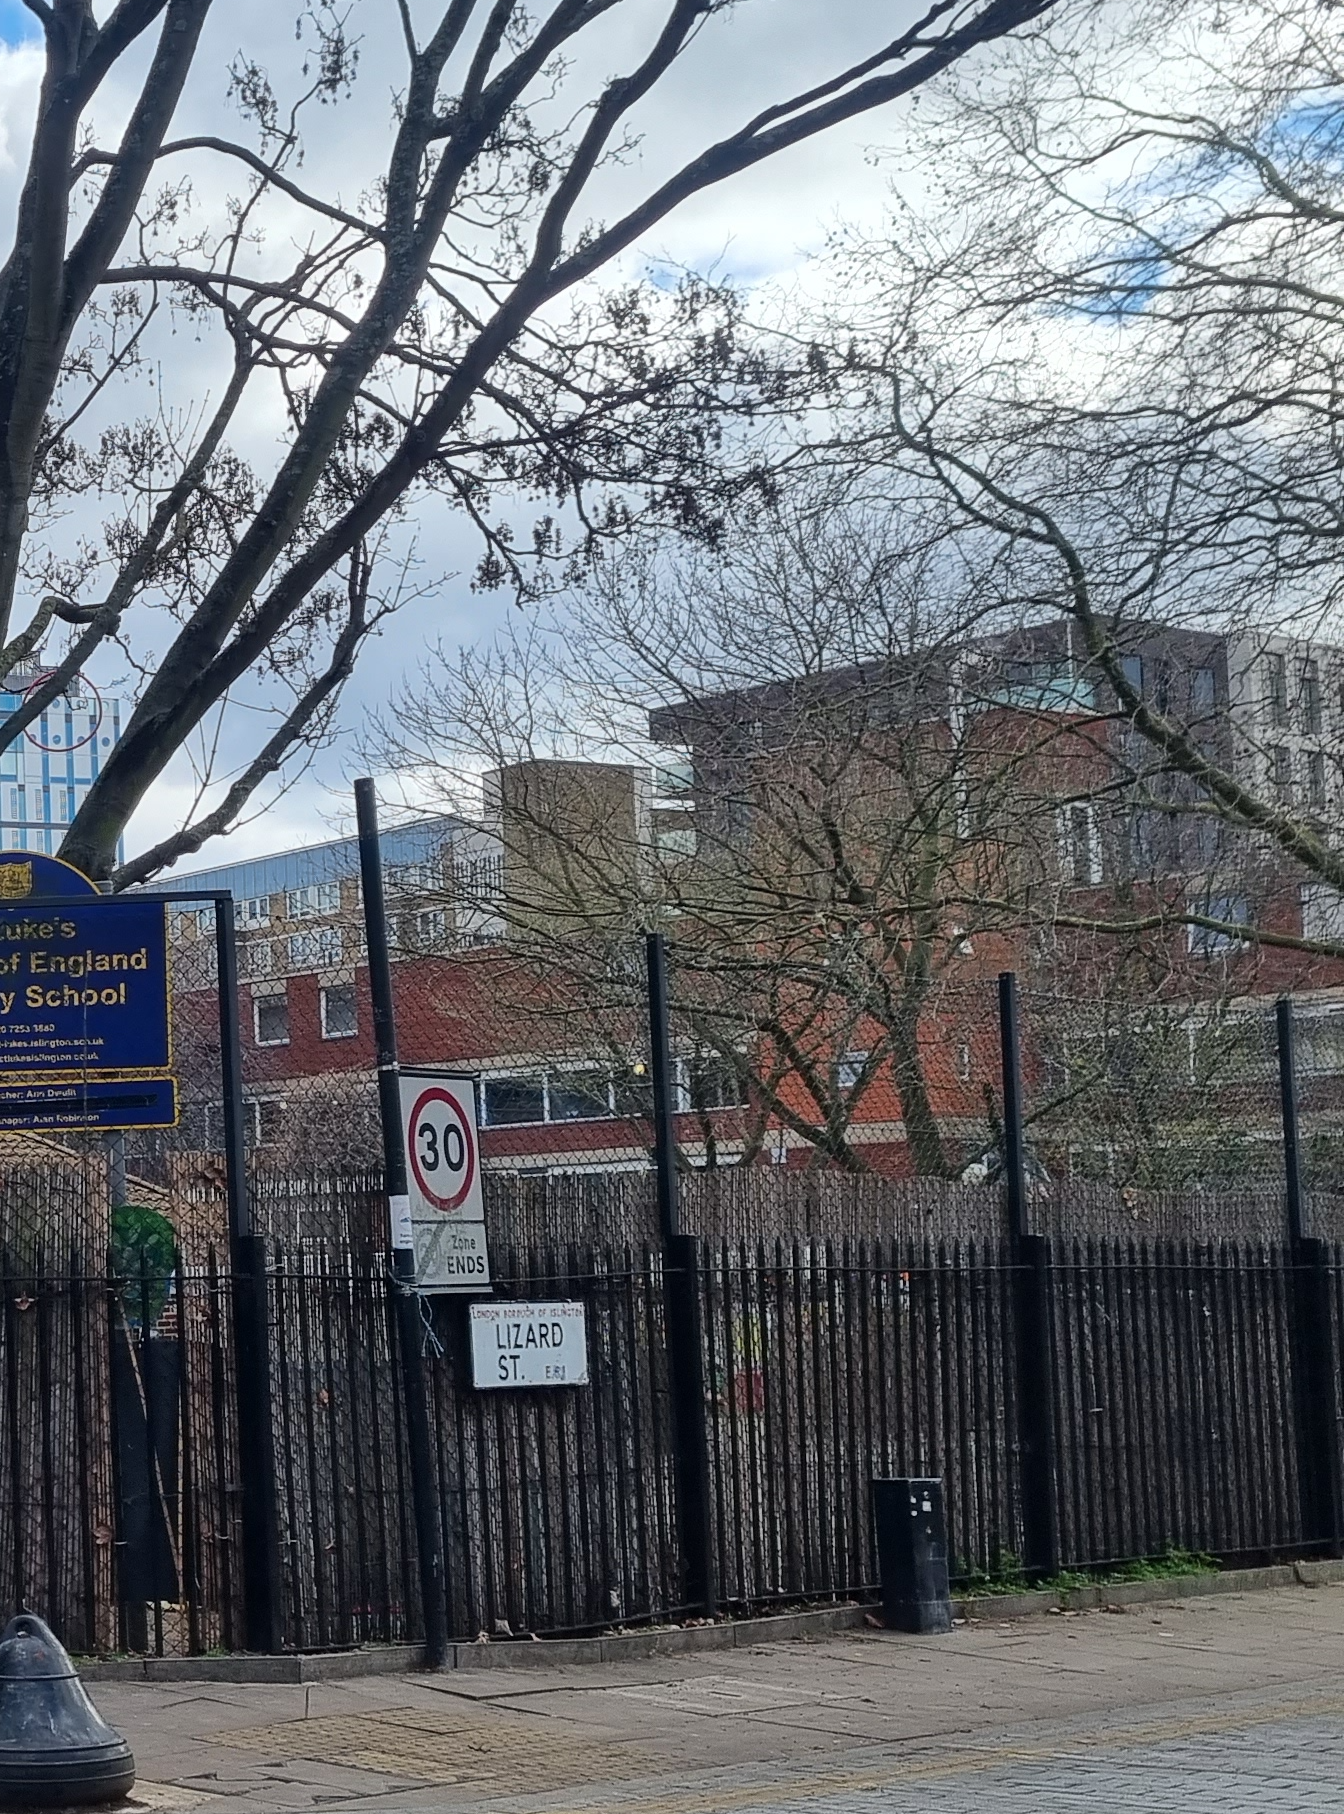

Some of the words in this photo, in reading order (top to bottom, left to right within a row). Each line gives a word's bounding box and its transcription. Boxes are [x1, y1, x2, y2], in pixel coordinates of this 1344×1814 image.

[29, 947, 148, 978] England
[25, 982, 127, 1009] School
[418, 1122, 465, 1172] 30
[449, 1234, 477, 1250] Zone
[446, 1255, 485, 1275] ENDS
[472, 1308, 500, 1320] LONDON
[503, 1307, 535, 1319] BOROUGH
[538, 1308, 547, 1318] OF
[550, 1307, 583, 1318] ISLINGTON
[496, 1322, 564, 1350] LIZARD
[498, 1354, 526, 1381] ST.
